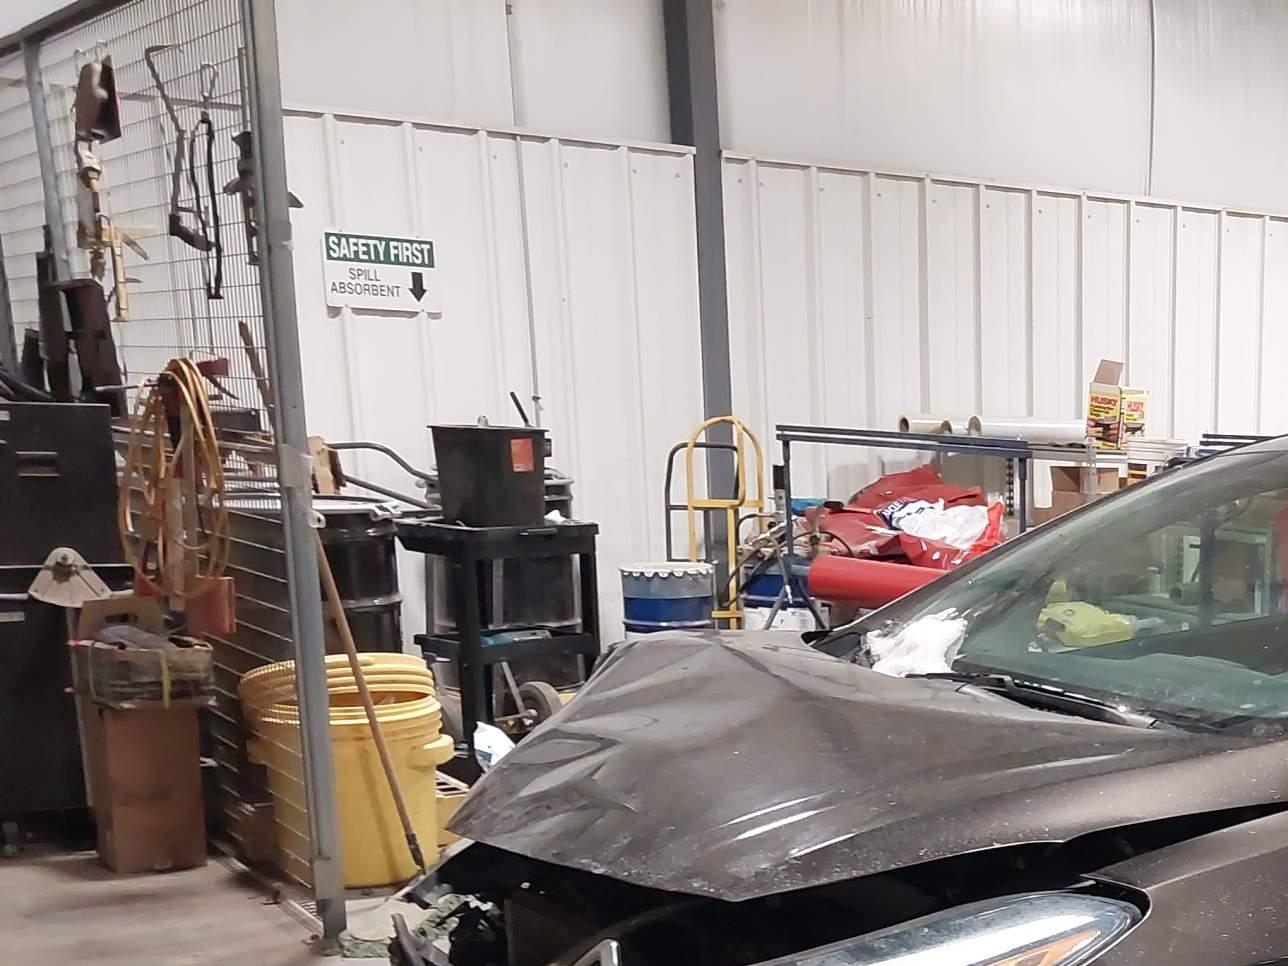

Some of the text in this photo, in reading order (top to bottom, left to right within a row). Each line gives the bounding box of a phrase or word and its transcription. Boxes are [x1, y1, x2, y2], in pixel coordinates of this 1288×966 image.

[328, 235, 430, 265] SAFETY FIRST
[348, 267, 381, 281] SPILL
[330, 281, 401, 297] ABSORBENT
[1090, 396, 1118, 406] HUSKY
